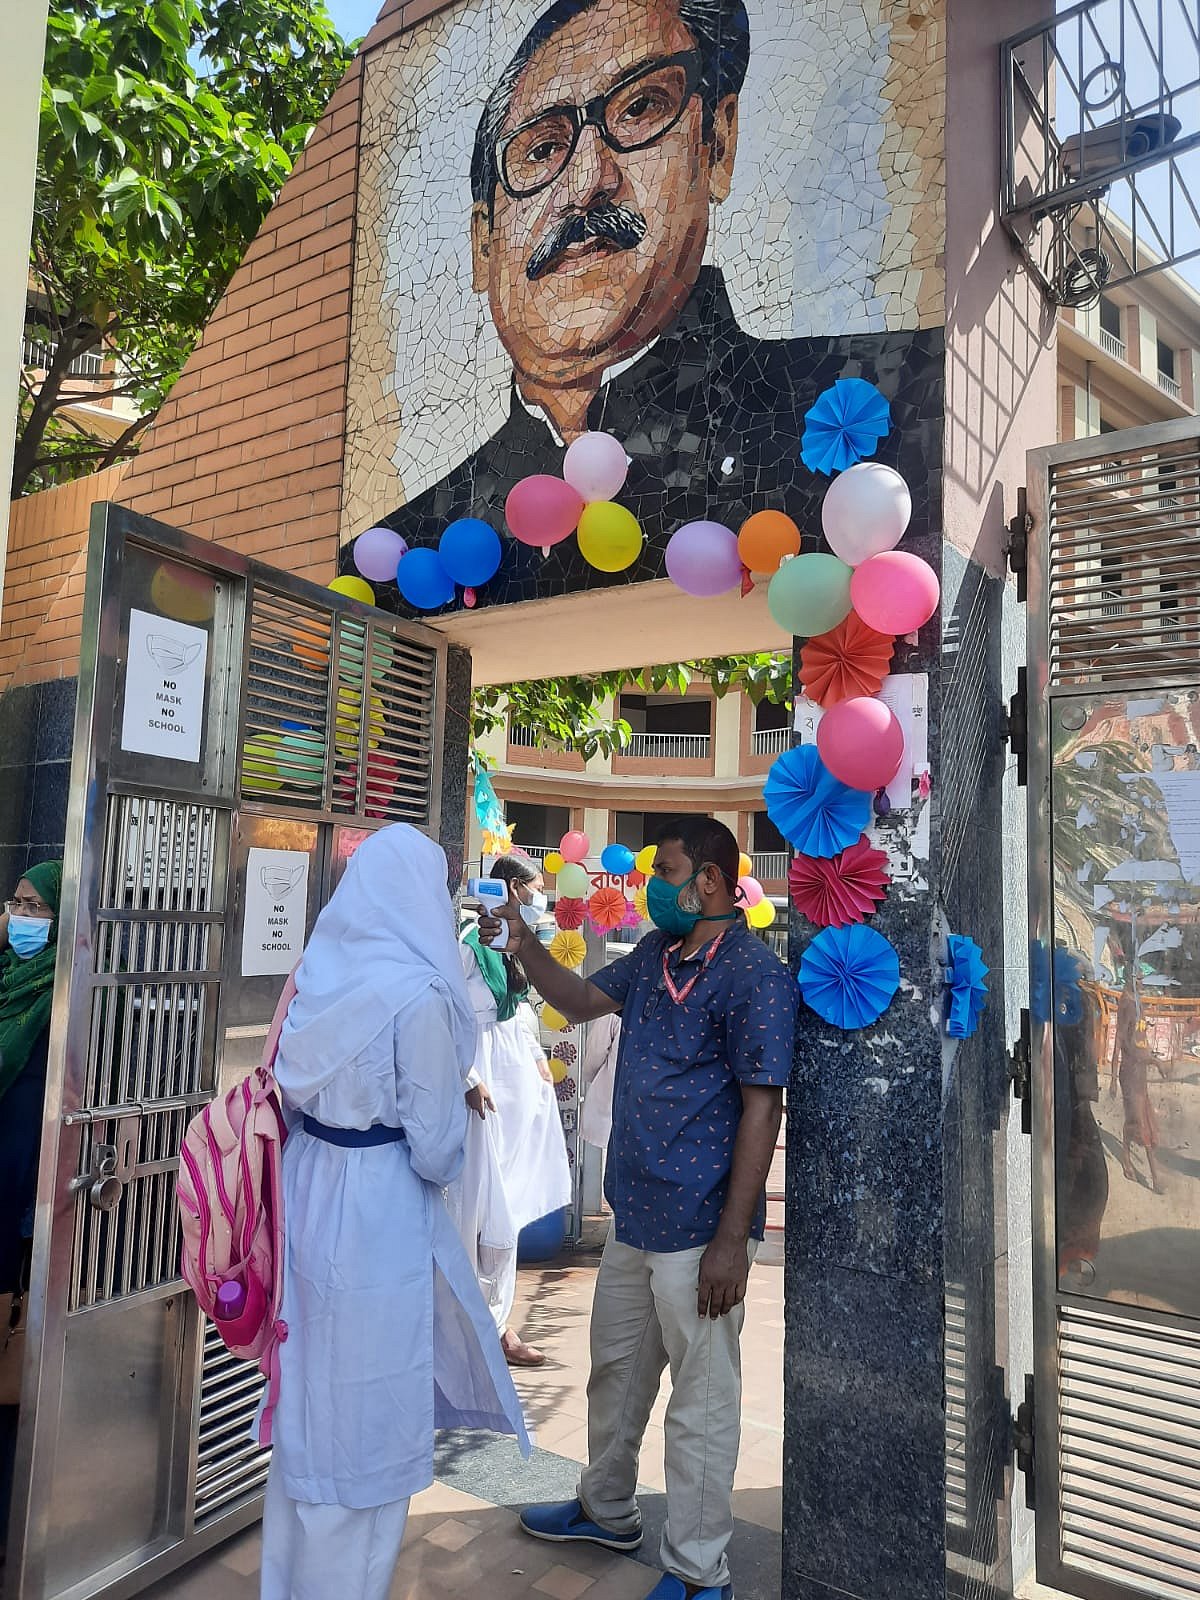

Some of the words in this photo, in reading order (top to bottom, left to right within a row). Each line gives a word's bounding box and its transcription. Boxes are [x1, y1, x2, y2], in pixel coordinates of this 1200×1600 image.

[163, 680, 176, 690] NO
[156, 692, 182, 705] MASK
[161, 707, 175, 718] NO
[148, 719, 185, 733] SCHOOL
[273, 905, 284, 913] NO
[267, 917, 288, 925] MASK
[272, 930, 282, 938] NO
[261, 943, 291, 951] SCHOOL
